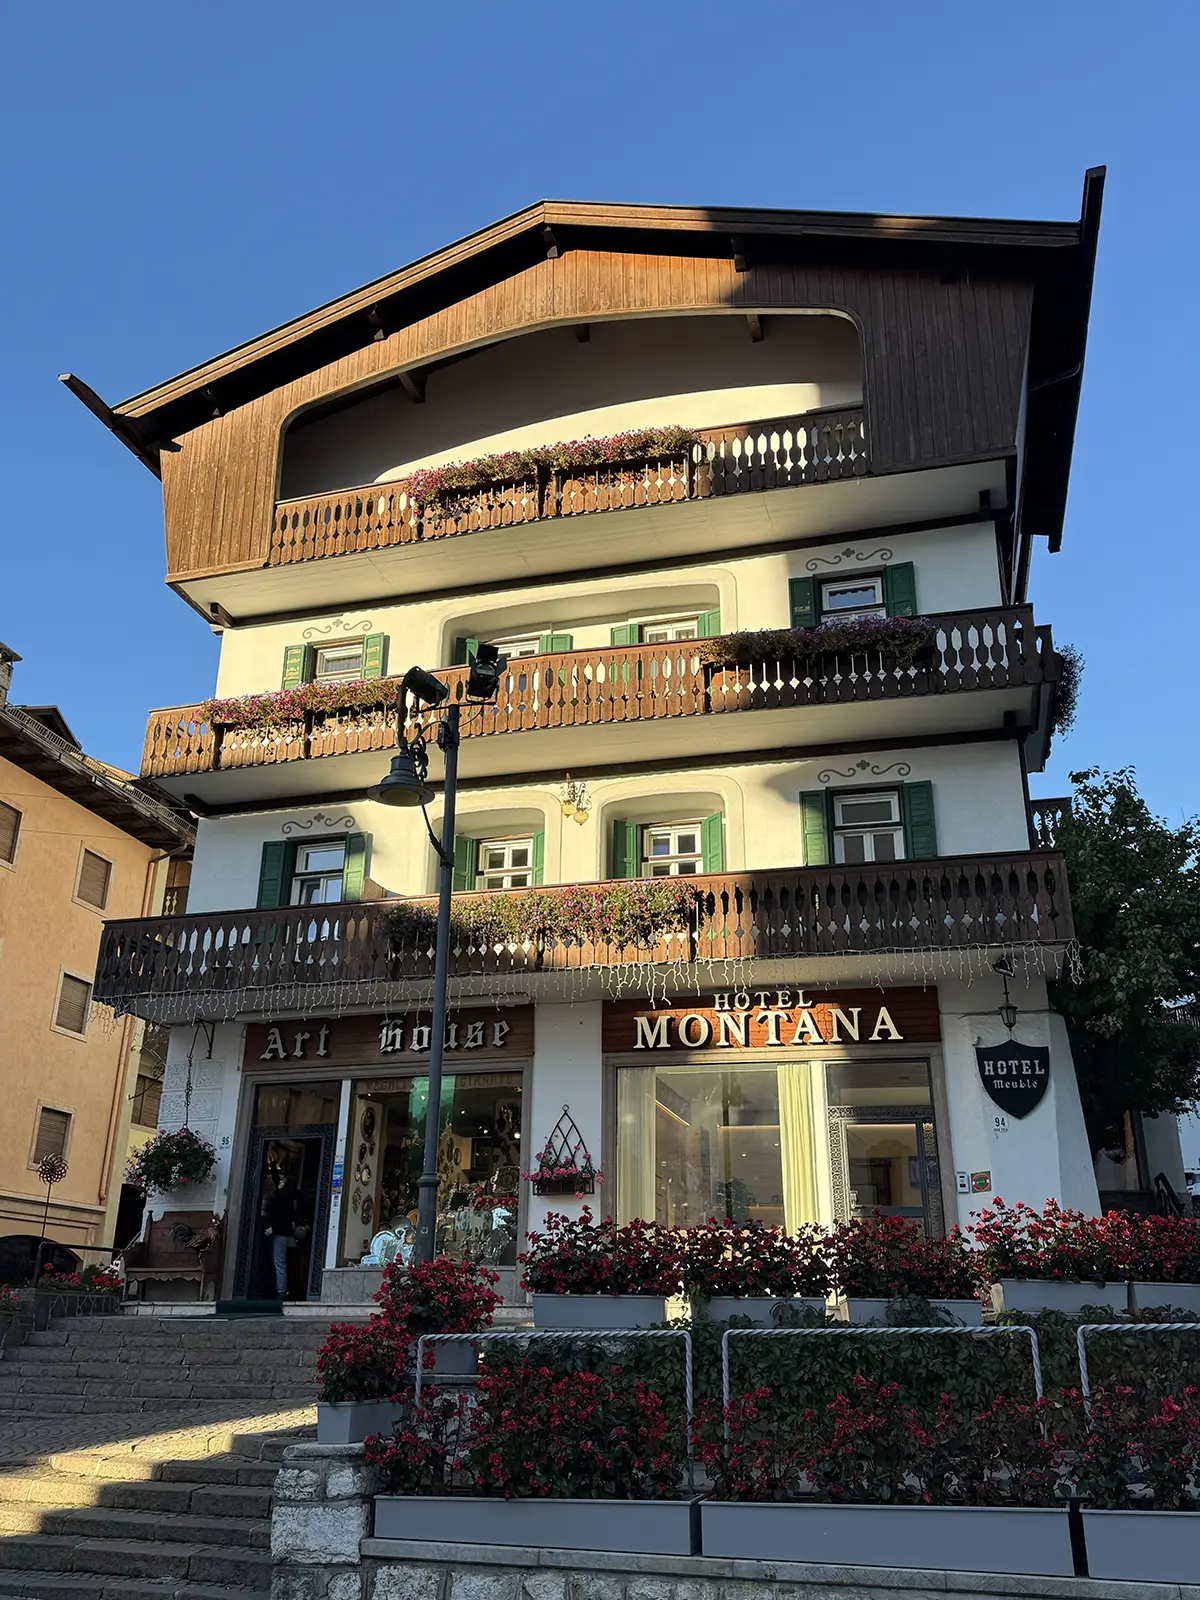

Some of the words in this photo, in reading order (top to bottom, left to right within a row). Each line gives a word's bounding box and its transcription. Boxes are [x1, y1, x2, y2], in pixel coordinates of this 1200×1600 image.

[714, 988, 813, 1011] HOTEL
[633, 1006, 904, 1050] MONTANA
[259, 1023, 330, 1061] Art
[378, 1019, 511, 1053] House
[983, 1059, 1045, 1076] HOTEL
[994, 1117, 1006, 1128] 94
[221, 1136, 230, 1146] 95
